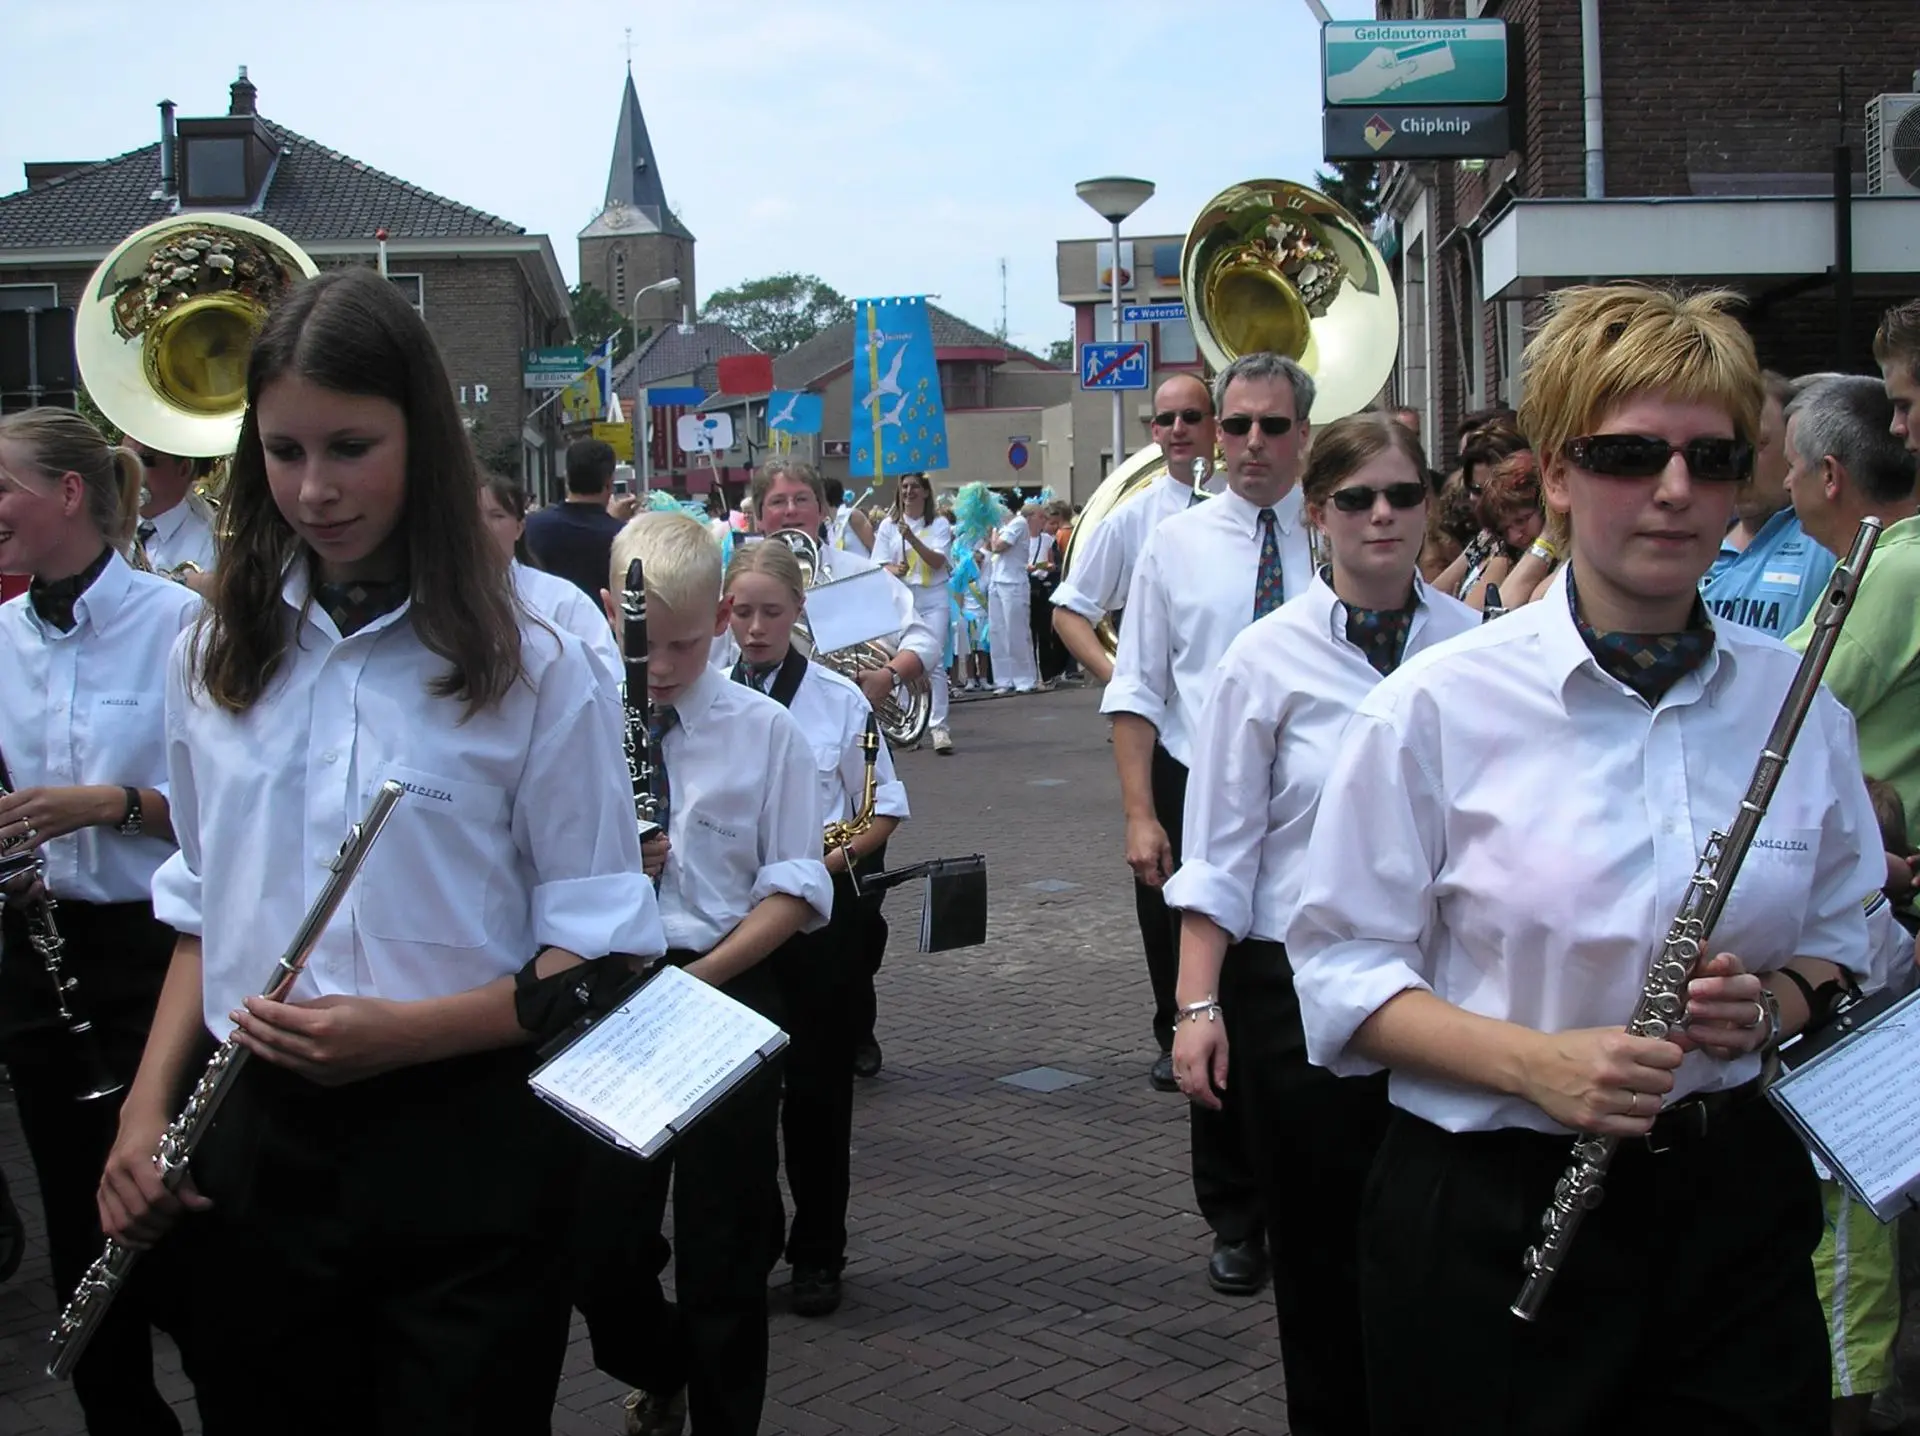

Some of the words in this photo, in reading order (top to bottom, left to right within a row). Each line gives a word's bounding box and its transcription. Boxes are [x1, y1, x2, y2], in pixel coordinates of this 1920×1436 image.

[1354, 27, 1468, 41] Geldautomaat
[1400, 117, 1471, 136] Chipknip
[402, 782, 453, 802] MICITIA
